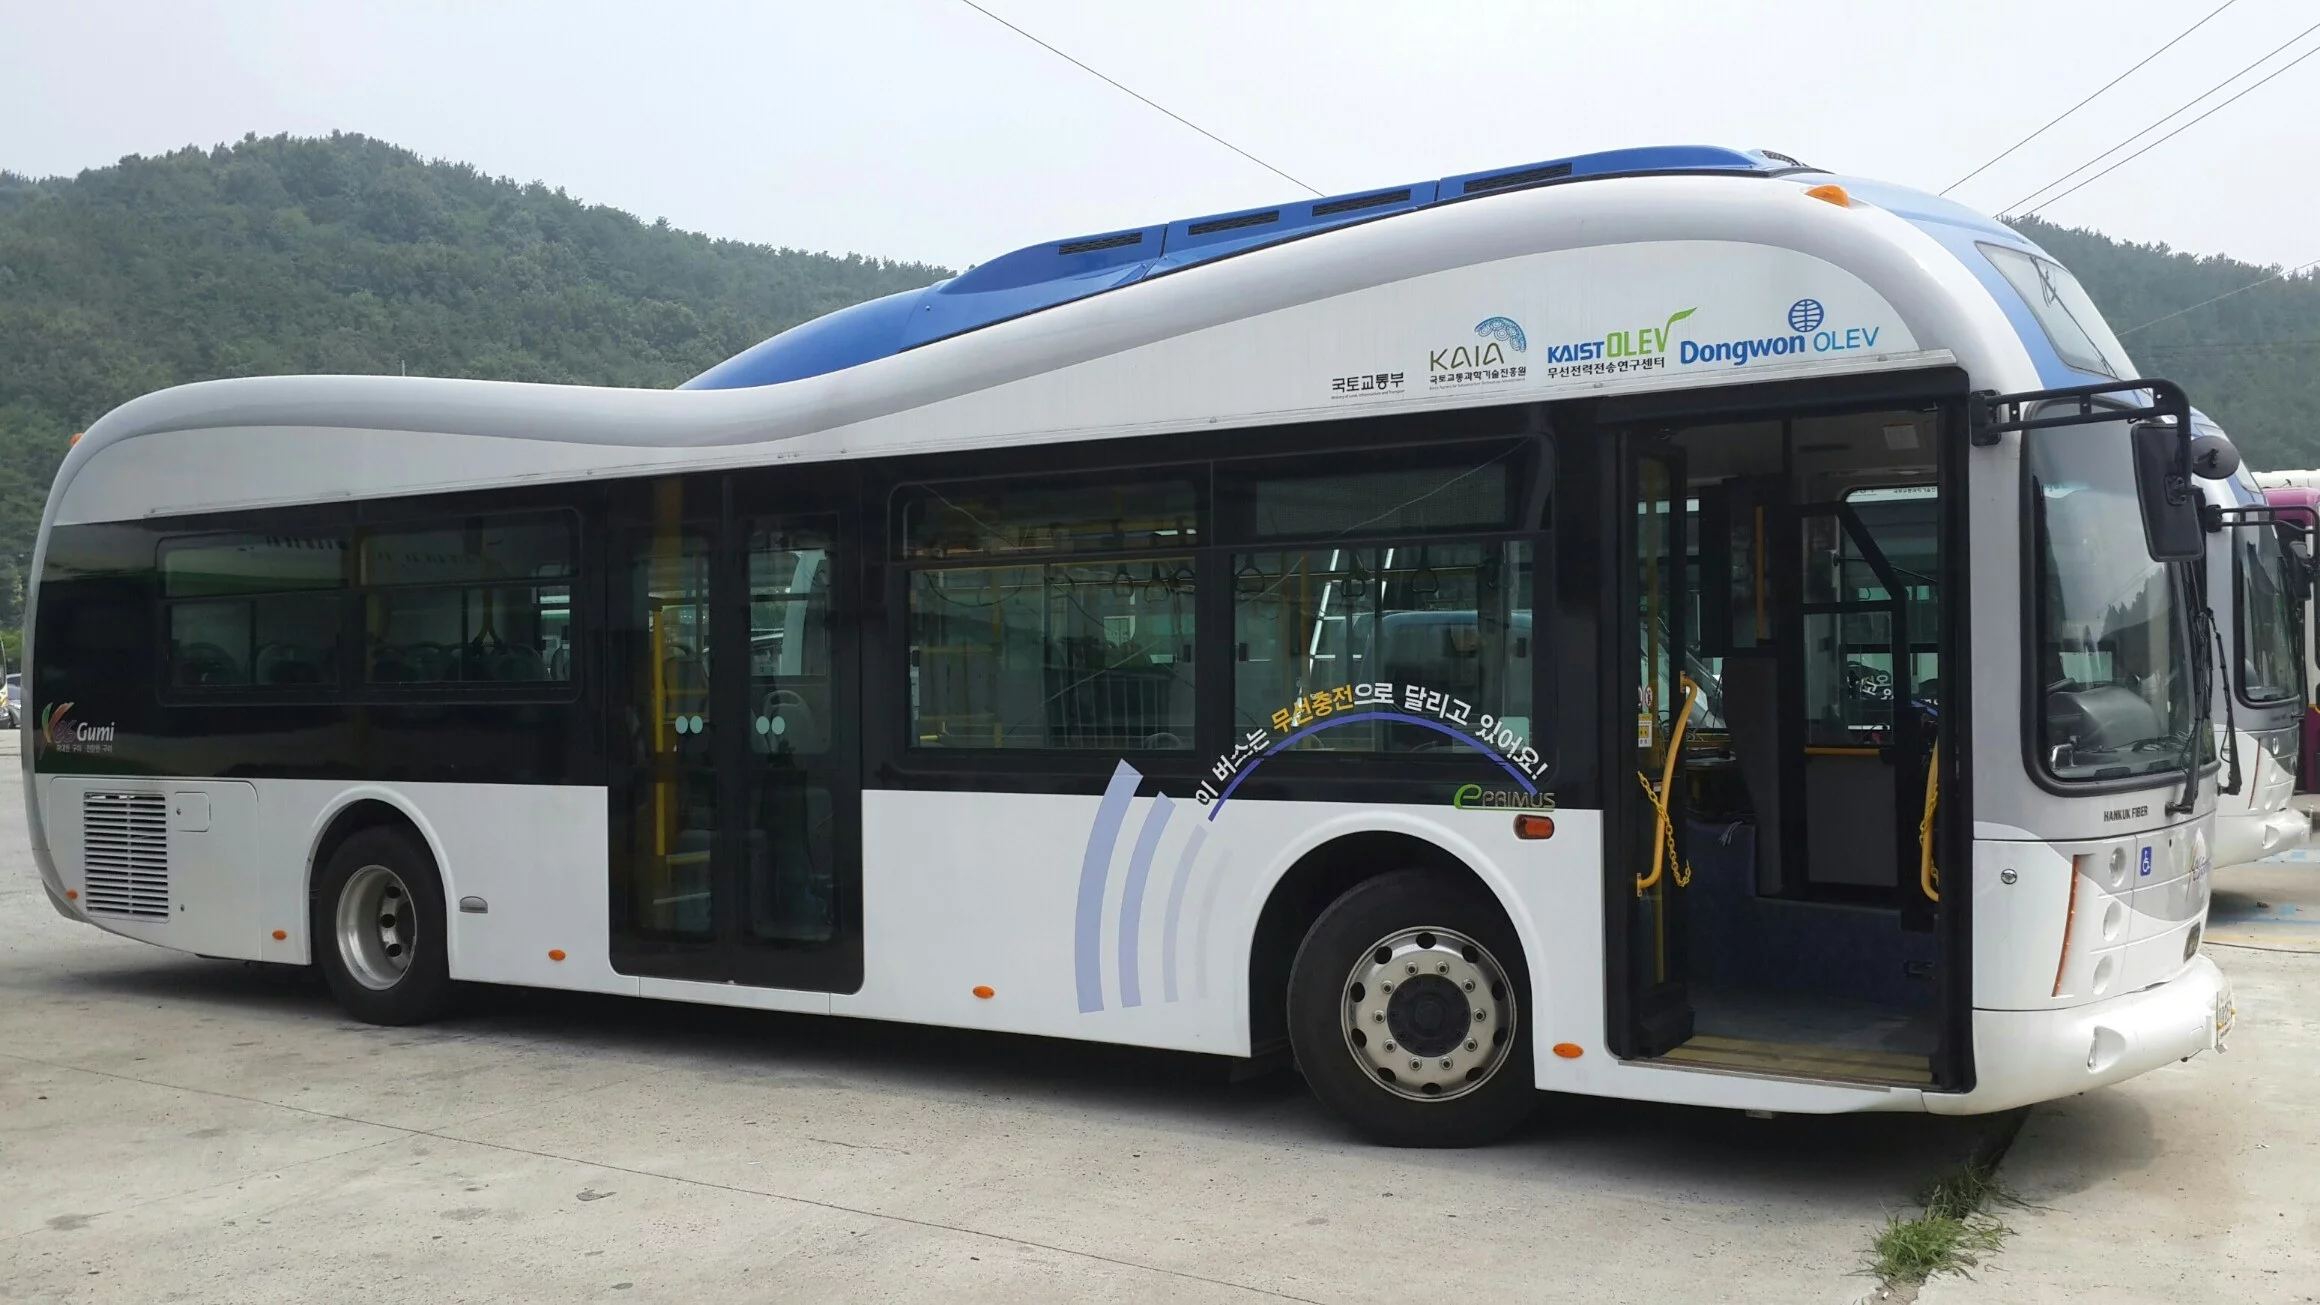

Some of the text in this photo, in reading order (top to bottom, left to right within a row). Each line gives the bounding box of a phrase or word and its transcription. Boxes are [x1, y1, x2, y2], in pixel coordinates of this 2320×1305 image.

[1429, 342, 1505, 372] KAIA
[1680, 326, 1880, 366] Dongwon OLEV
[1429, 366, 1527, 384] 국토교통과학기술진흥원
[1547, 356, 1666, 379] 무선전력전송연구센터
[1331, 372, 1404, 393] 국토교통부
[77, 721, 115, 742] Gumi
[1195, 682, 1550, 806] 이 버스는 무선충전으로 달리고 있어요!
[2103, 805, 2148, 822] HANKUK FIBER
